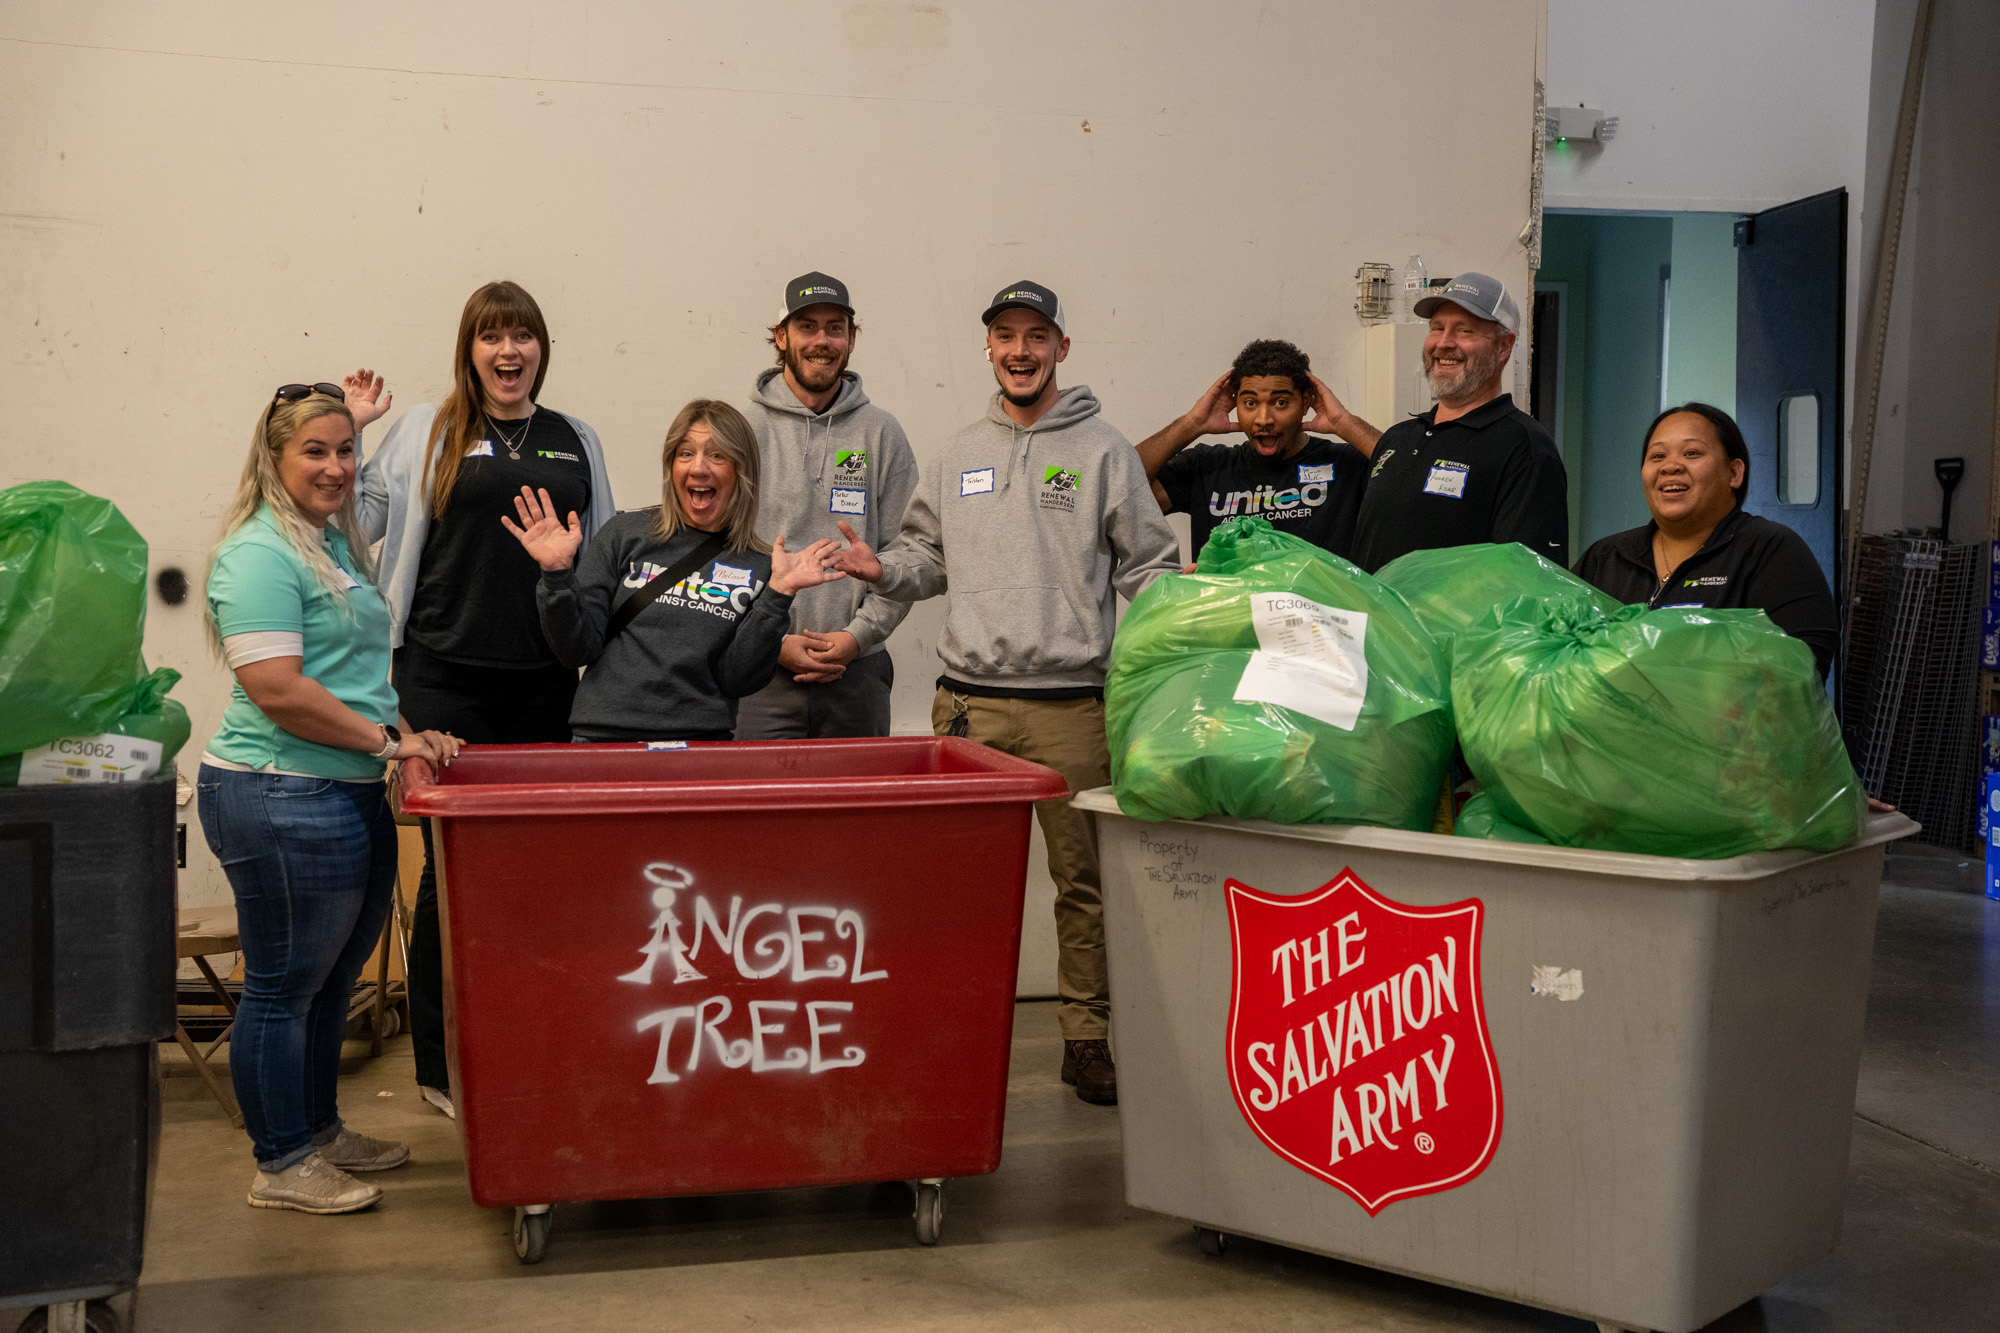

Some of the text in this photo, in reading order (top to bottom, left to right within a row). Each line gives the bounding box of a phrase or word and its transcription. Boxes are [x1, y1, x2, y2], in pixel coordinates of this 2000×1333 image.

[834, 474, 867, 482] RENEWAL
[1041, 491, 1076, 504] RENEWAL
[1209, 482, 1328, 517] united
[1266, 508, 1312, 521] CANCER
[687, 600, 737, 622] CANCER
[1140, 831, 1199, 862] Property
[1171, 855, 1184, 872] of
[616, 890, 889, 985] ANGEL
[1272, 911, 1367, 1008] THE
[636, 995, 866, 1085] TREE
[1247, 936, 1459, 1112] SALVATION
[1328, 1034, 1456, 1166] ARMY
